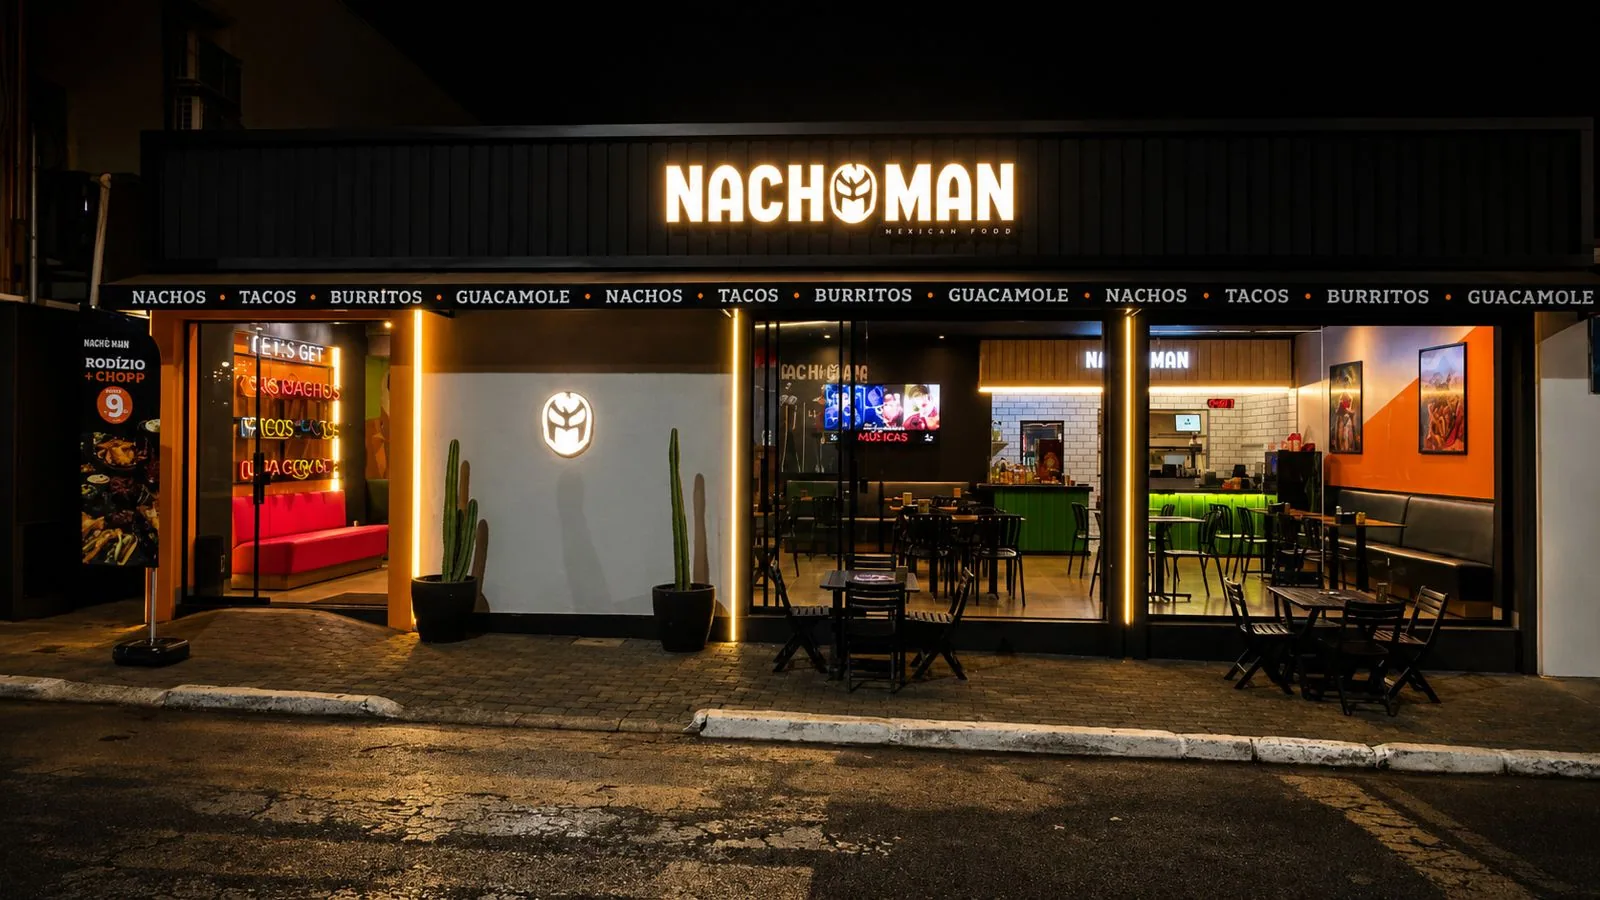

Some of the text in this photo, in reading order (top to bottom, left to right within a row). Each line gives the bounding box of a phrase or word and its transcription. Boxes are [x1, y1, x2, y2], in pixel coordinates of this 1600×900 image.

[131, 288, 1594, 304] NACHOS TACOS BURRITOS GUACAMOLE NACHOS TACOS BURRITOS GUACAMOLE NACHOS TACOS BURRITOS GUACAMOLE
[299, 343, 324, 362] GET
[85, 356, 146, 370] RODÍZIO
[95, 371, 146, 383] CHOPP
[105, 394, 124, 418] 9
